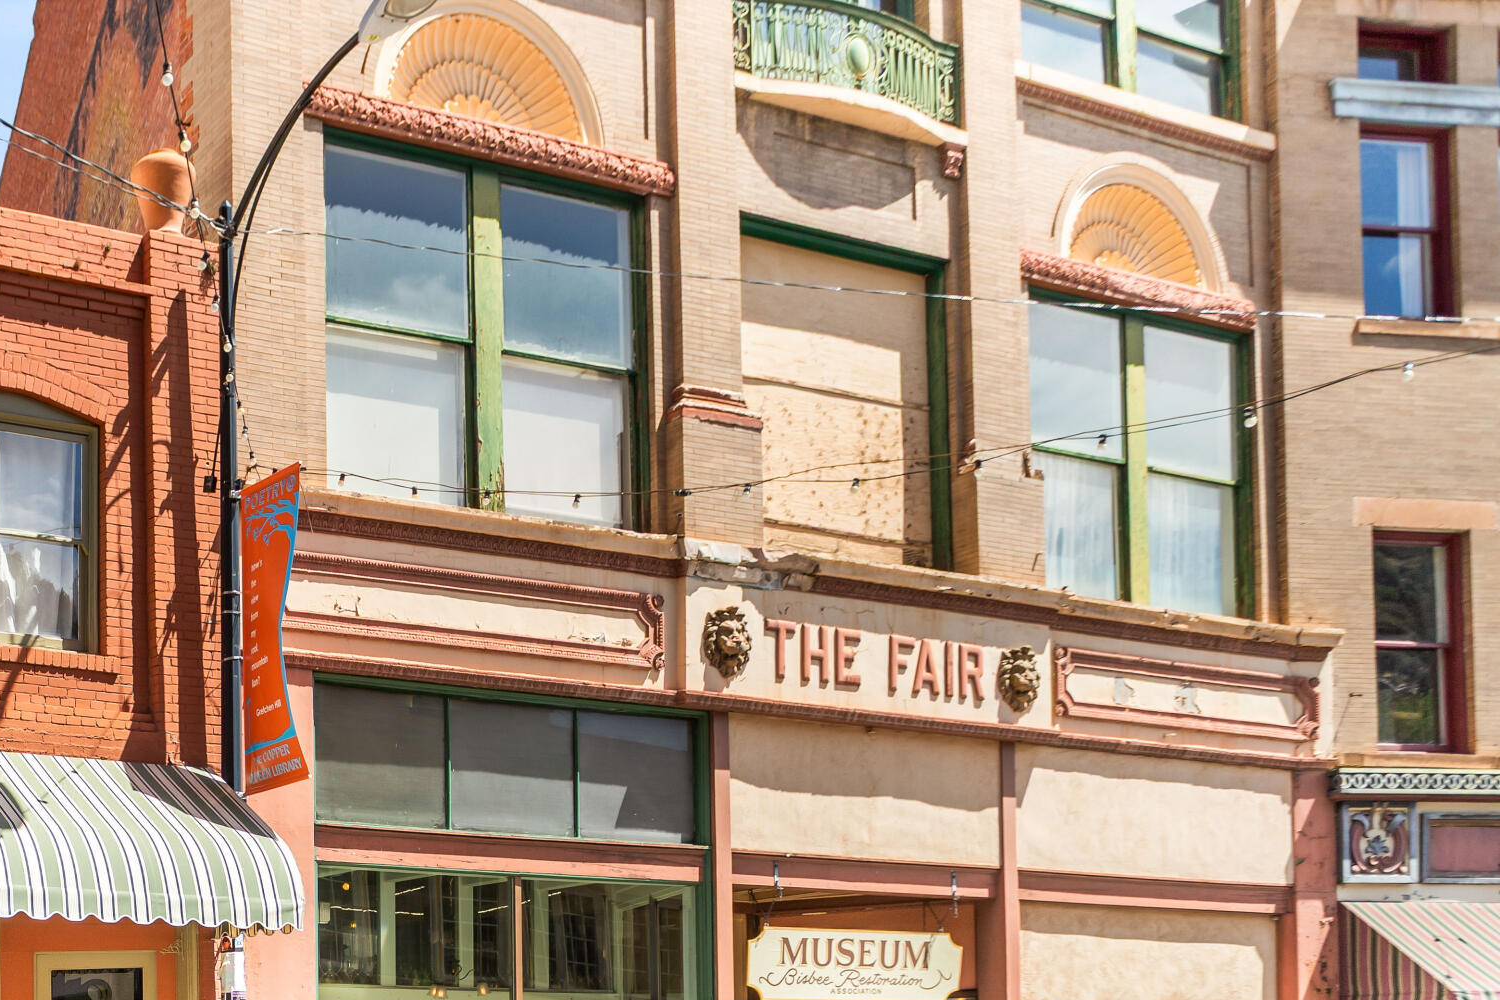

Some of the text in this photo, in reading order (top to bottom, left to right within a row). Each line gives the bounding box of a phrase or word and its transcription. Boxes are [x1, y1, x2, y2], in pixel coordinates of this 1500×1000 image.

[765, 618, 984, 701] THE FAIR
[256, 704, 274, 717] Gretchen
[262, 744, 290, 762] COPPER
[272, 757, 302, 776] LIBRARY
[778, 936, 932, 971] MUSEUM
[760, 968, 952, 989] Bisbee Restoration
